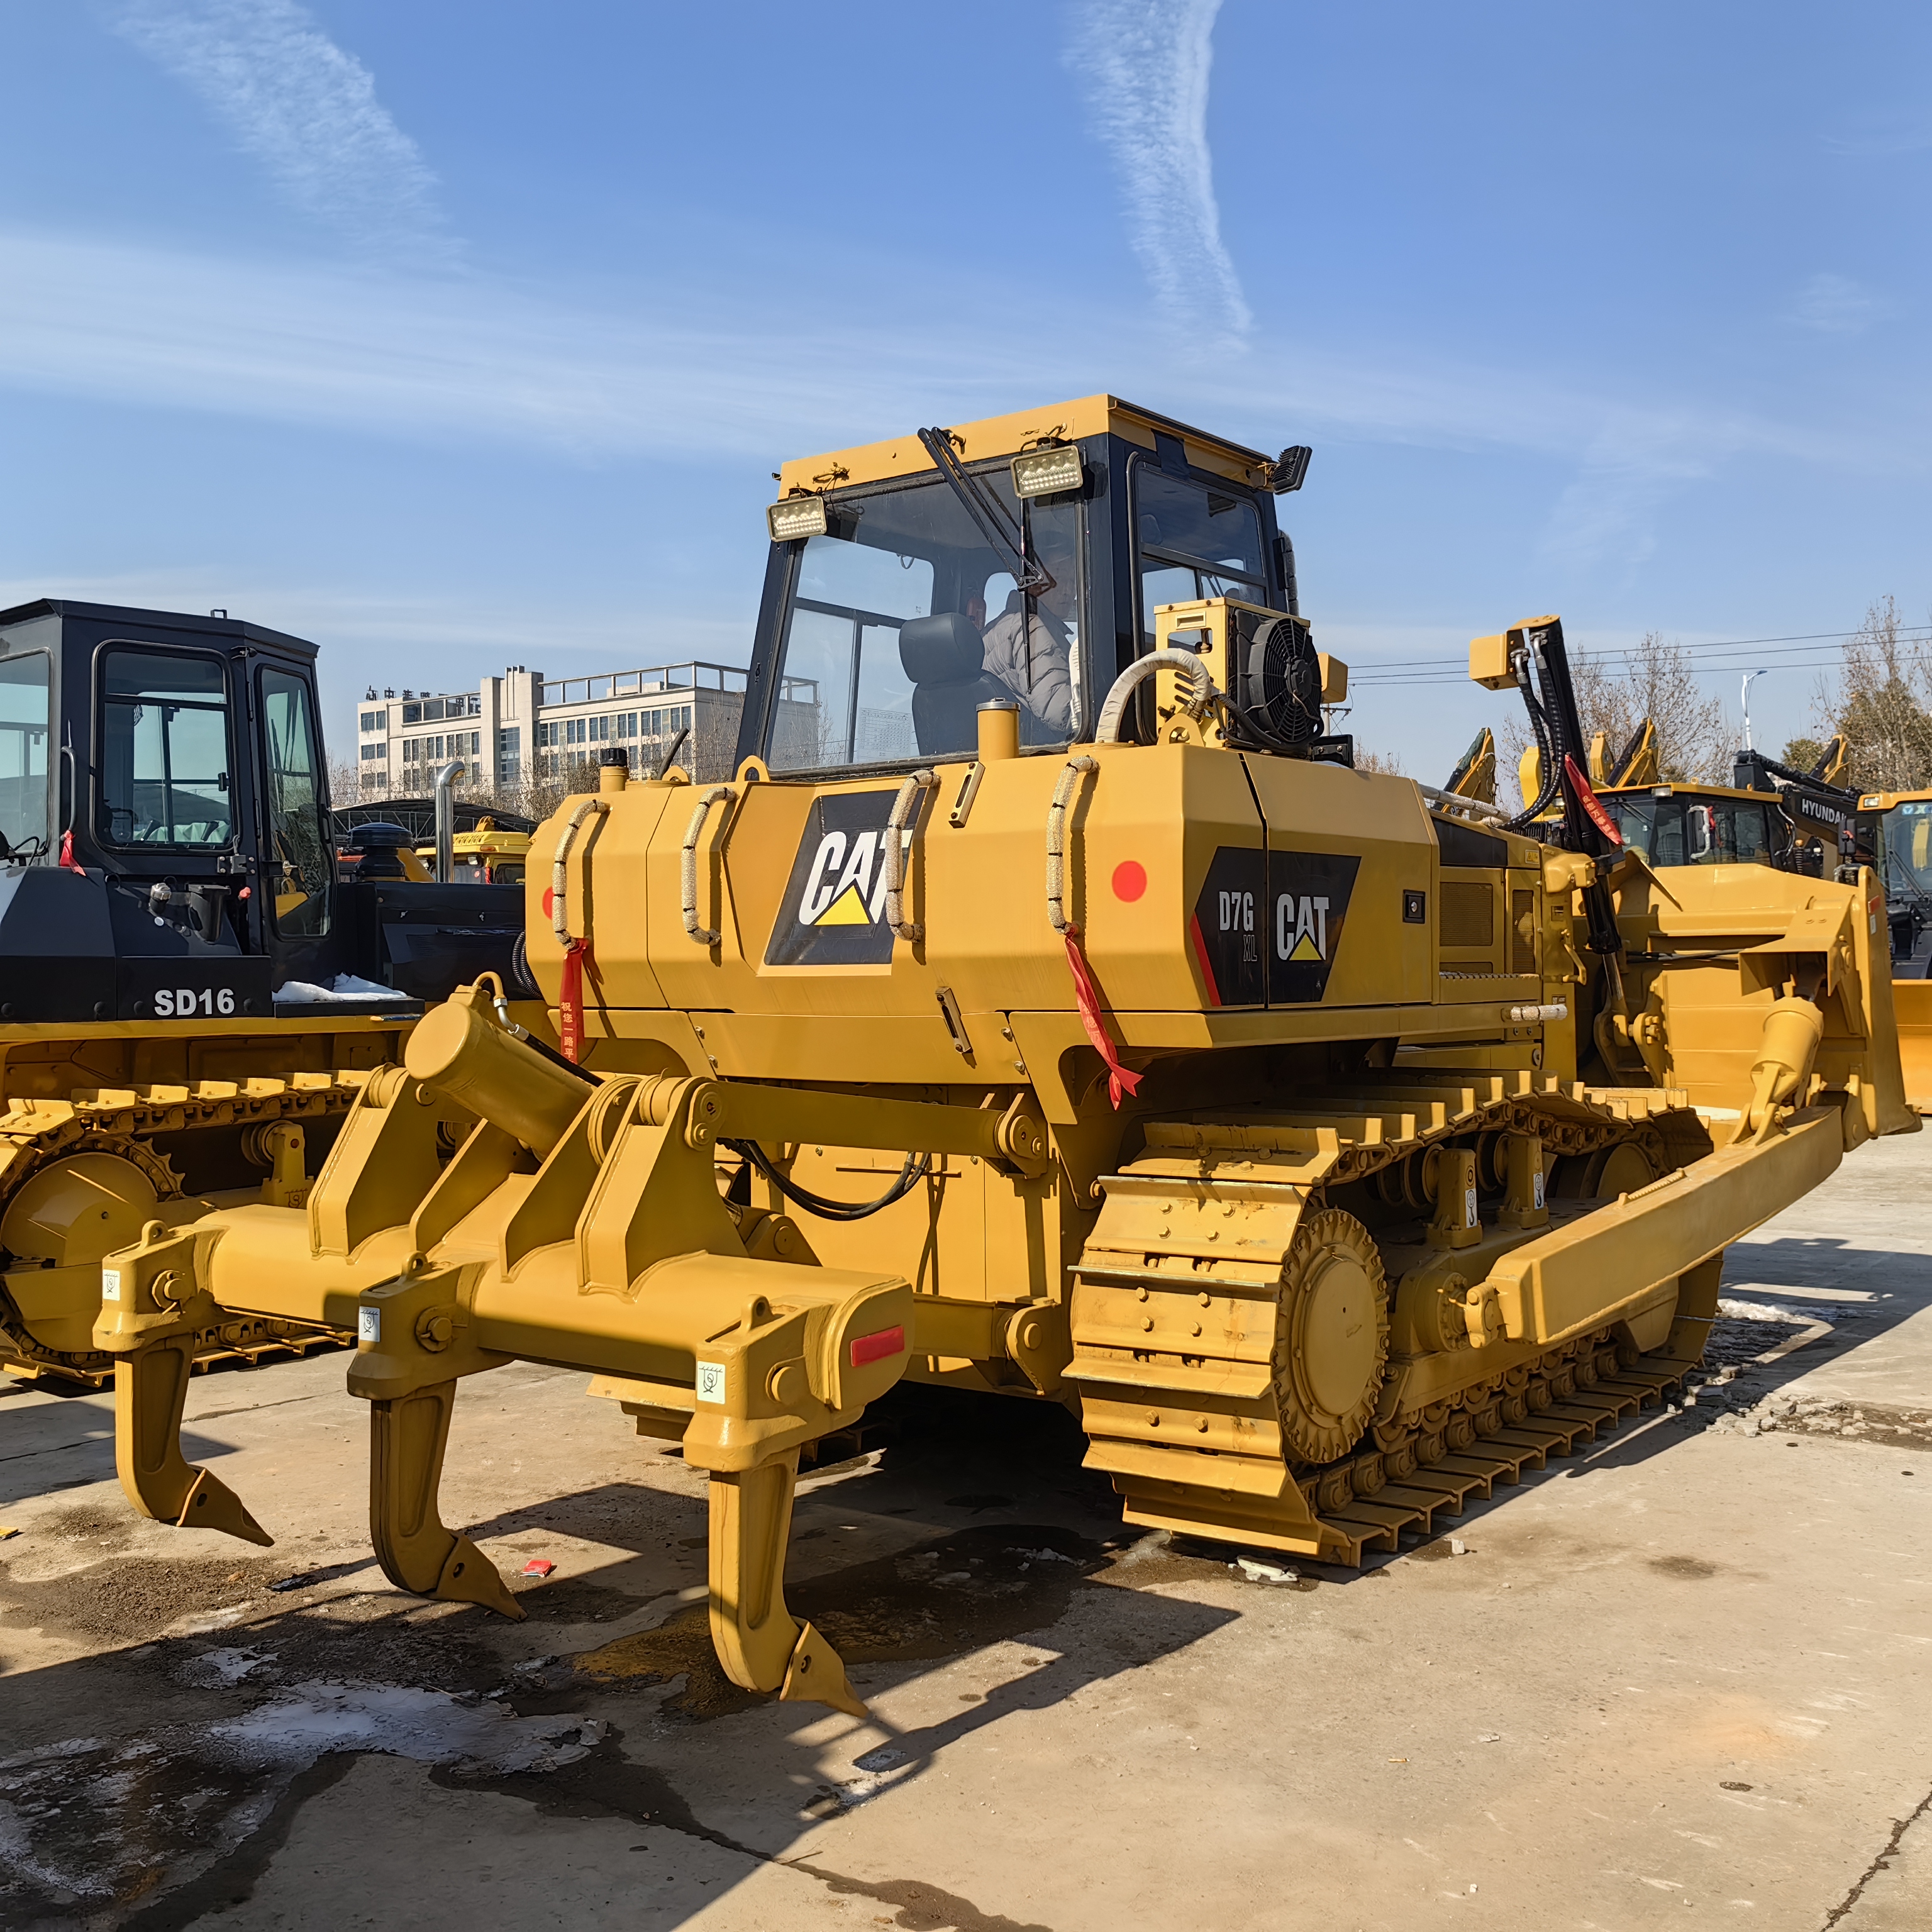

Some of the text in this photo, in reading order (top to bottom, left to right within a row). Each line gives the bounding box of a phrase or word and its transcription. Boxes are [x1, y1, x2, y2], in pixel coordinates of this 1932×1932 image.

[799, 830, 913, 925] CAT
[1219, 891, 1254, 931] D7G
[1277, 894, 1330, 960] CAT
[1243, 935, 1257, 962] XL
[154, 989, 235, 1016] SD16
[561, 1001, 574, 1063] 祝您一路平
